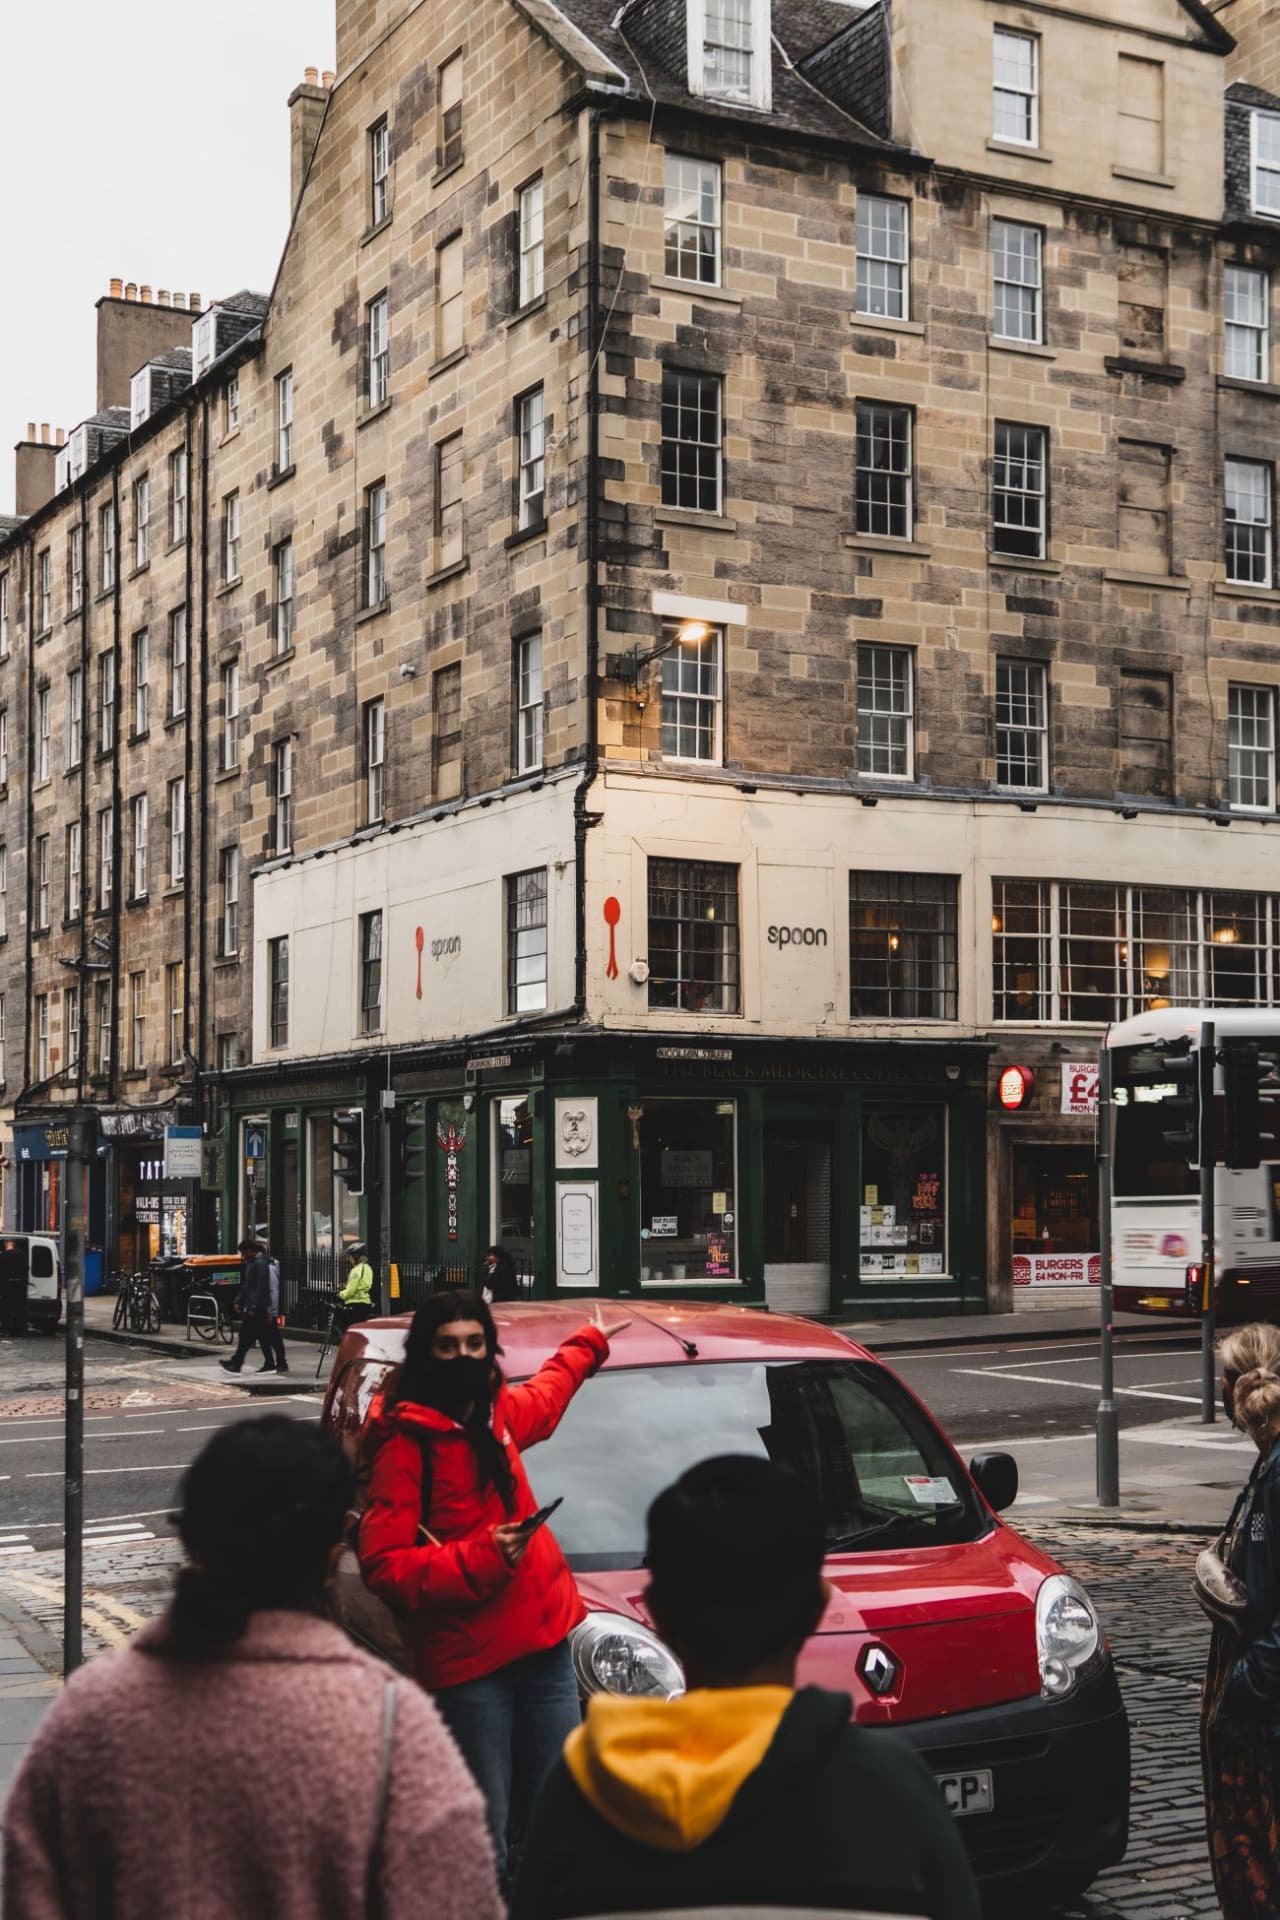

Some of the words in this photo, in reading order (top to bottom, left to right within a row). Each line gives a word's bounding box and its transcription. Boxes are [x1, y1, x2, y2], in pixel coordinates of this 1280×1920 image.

[768, 925, 828, 951] spoon
[432, 936, 461, 962] spoon
[658, 1049, 698, 1059] NICOLSON
[702, 1049, 731, 1060] STREET
[703, 1064, 755, 1079] BLACK
[1069, 1065, 1098, 1073] BURGE
[1070, 1074, 1100, 1104] £4
[136, 1197, 160, 1208] WALK-INS
[1035, 1259, 1083, 1270] BURGERS
[1013, 1270, 1031, 1279] RGR
[1035, 1272, 1046, 1281] £4
[1048, 1271, 1083, 1281] MON-FRI
[1088, 1268, 1100, 1277] BR
[941, 1776, 979, 1809] CP
